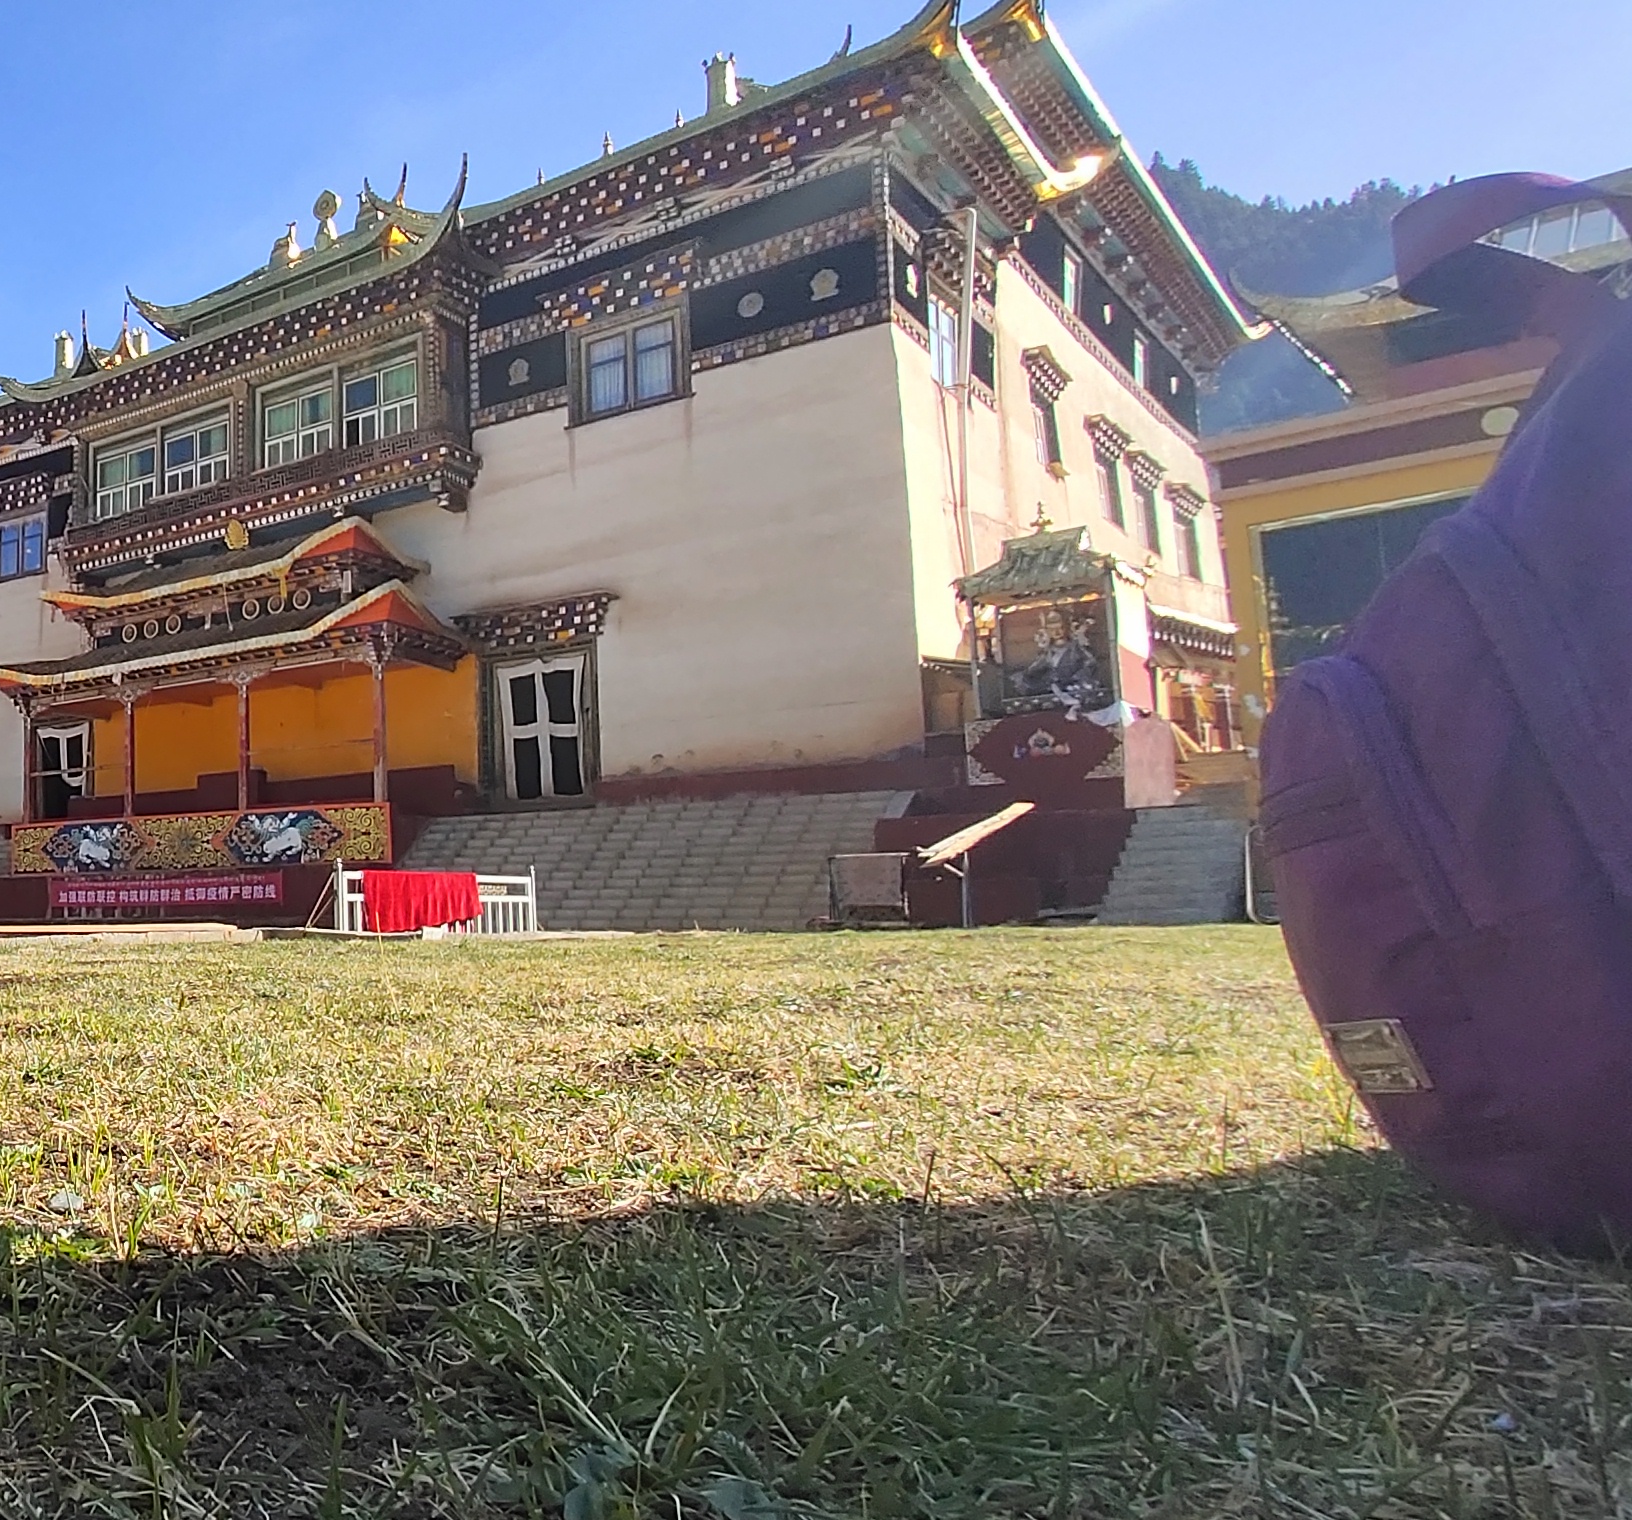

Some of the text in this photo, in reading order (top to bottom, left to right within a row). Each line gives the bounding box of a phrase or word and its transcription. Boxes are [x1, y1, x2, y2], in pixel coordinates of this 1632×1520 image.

[59, 884, 276, 903] 加强联防联控 构筑群防群治 抵御疫情严密防线
